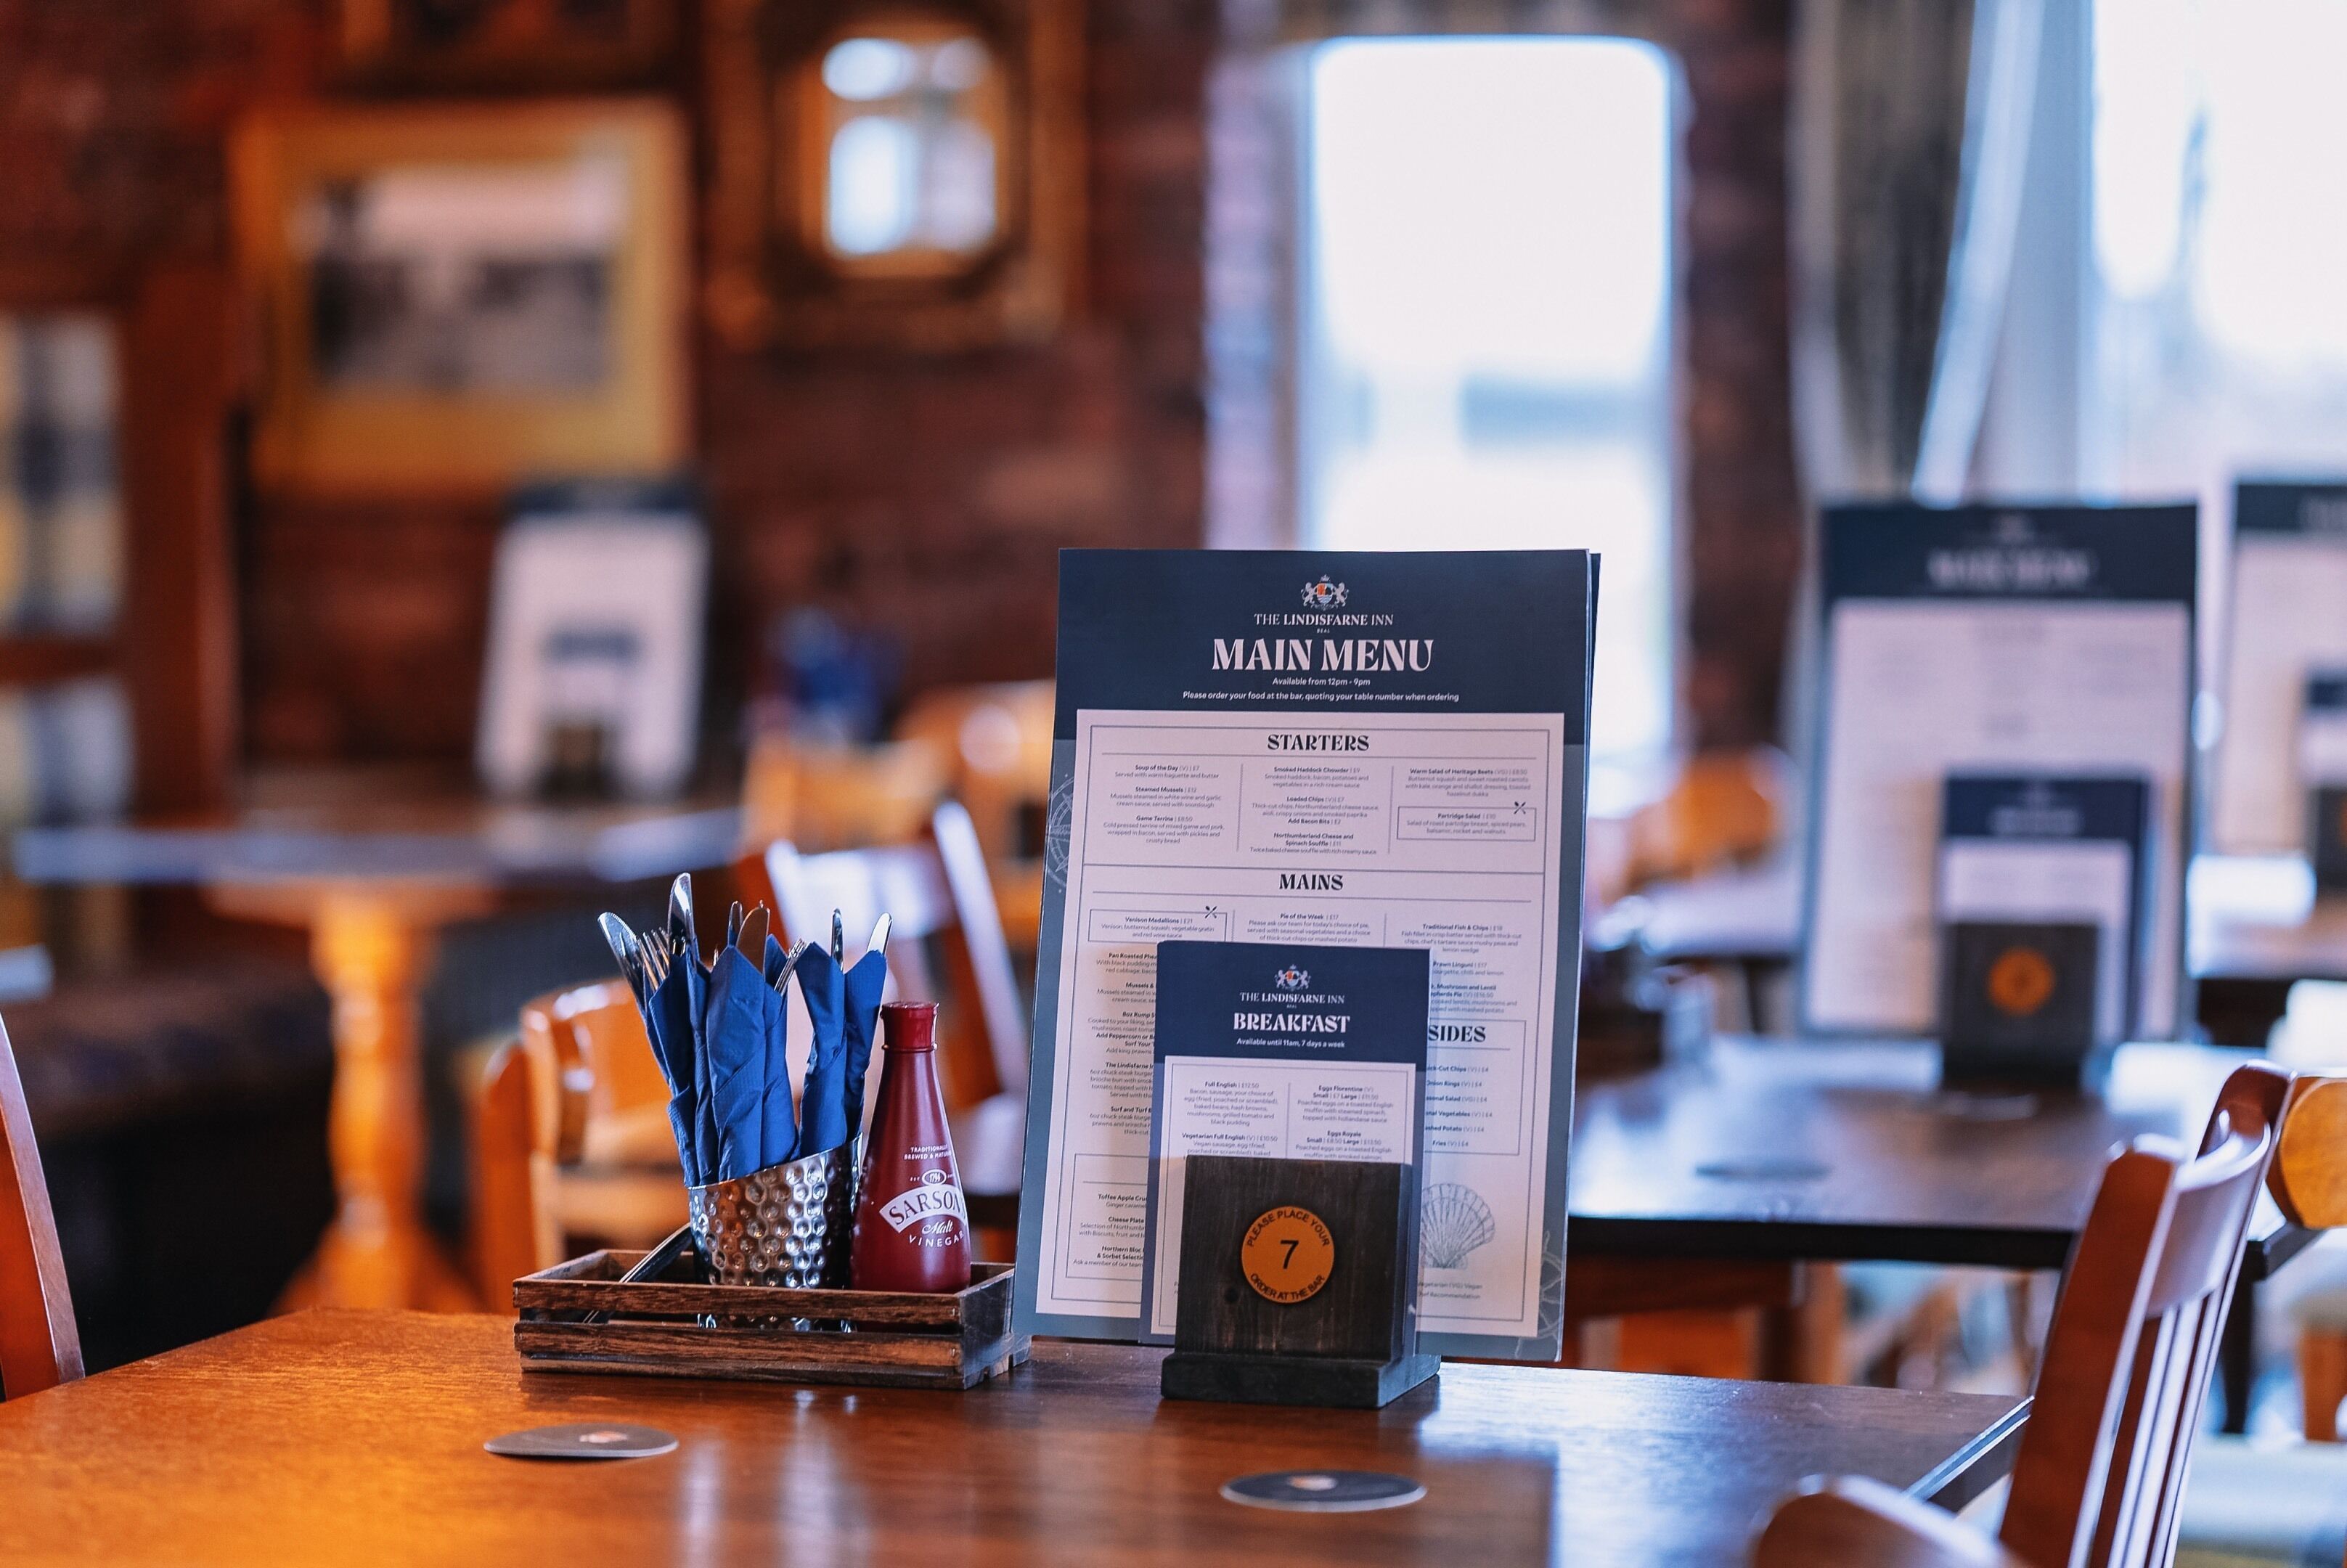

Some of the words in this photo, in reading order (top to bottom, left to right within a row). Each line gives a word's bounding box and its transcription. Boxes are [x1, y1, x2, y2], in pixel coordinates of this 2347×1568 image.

[1254, 613, 1280, 625] THE
[1283, 614, 1368, 626] LINDISFARNE
[1371, 614, 1394, 626] INN
[1212, 638, 1313, 671] MAIN
[1321, 639, 1434, 671] MENU
[1328, 678, 1347, 687] 12pm
[1354, 678, 1370, 687] 9pm
[1290, 693, 1304, 701] bar,
[1305, 693, 1334, 701] quoting
[1427, 693, 1458, 702] ordering
[1267, 734, 1370, 752] STARTERS
[1279, 874, 1343, 891] MAINS
[1240, 992, 1260, 1001] THE
[1262, 993, 1325, 1004] LINDISFARNE
[1328, 995, 1344, 1004] INN
[1233, 1013, 1350, 1033] BREAKFAST
[1428, 1026, 1486, 1042] SIDES
[922, 1220, 953, 1235] Malt
[1247, 1214, 1275, 1247] PLEASE
[1277, 1209, 1309, 1222] PLACE
[1311, 1219, 1330, 1246] YOUR
[909, 1230, 964, 1247] VINEGAR
[1281, 1240, 1299, 1270] 7
[1251, 1273, 1277, 1297] ORDER
[1291, 1288, 1307, 1299] THE
[1308, 1275, 1325, 1292] BAR
